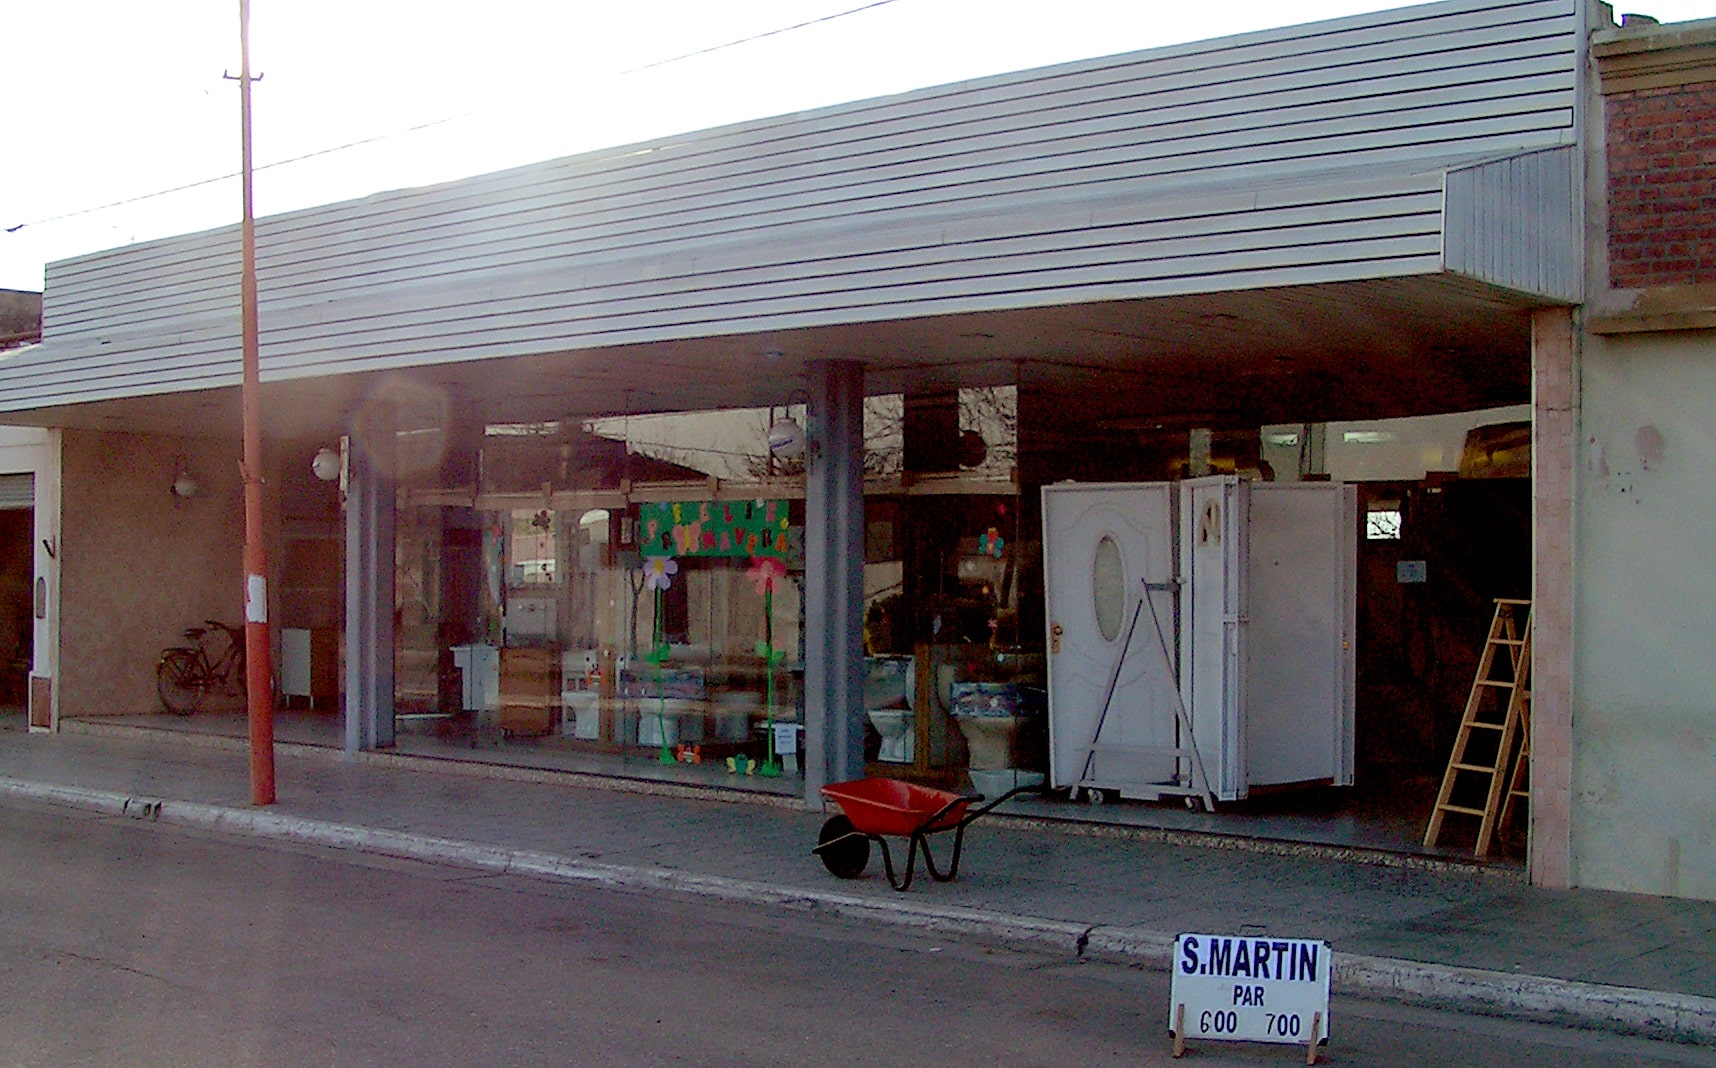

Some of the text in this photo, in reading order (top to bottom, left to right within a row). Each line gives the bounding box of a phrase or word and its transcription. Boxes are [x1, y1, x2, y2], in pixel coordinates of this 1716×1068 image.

[1181, 936, 1318, 981] S.MARTIN
[1233, 984, 1265, 1007] PAR
[1200, 1010, 1300, 1037] 600 700
